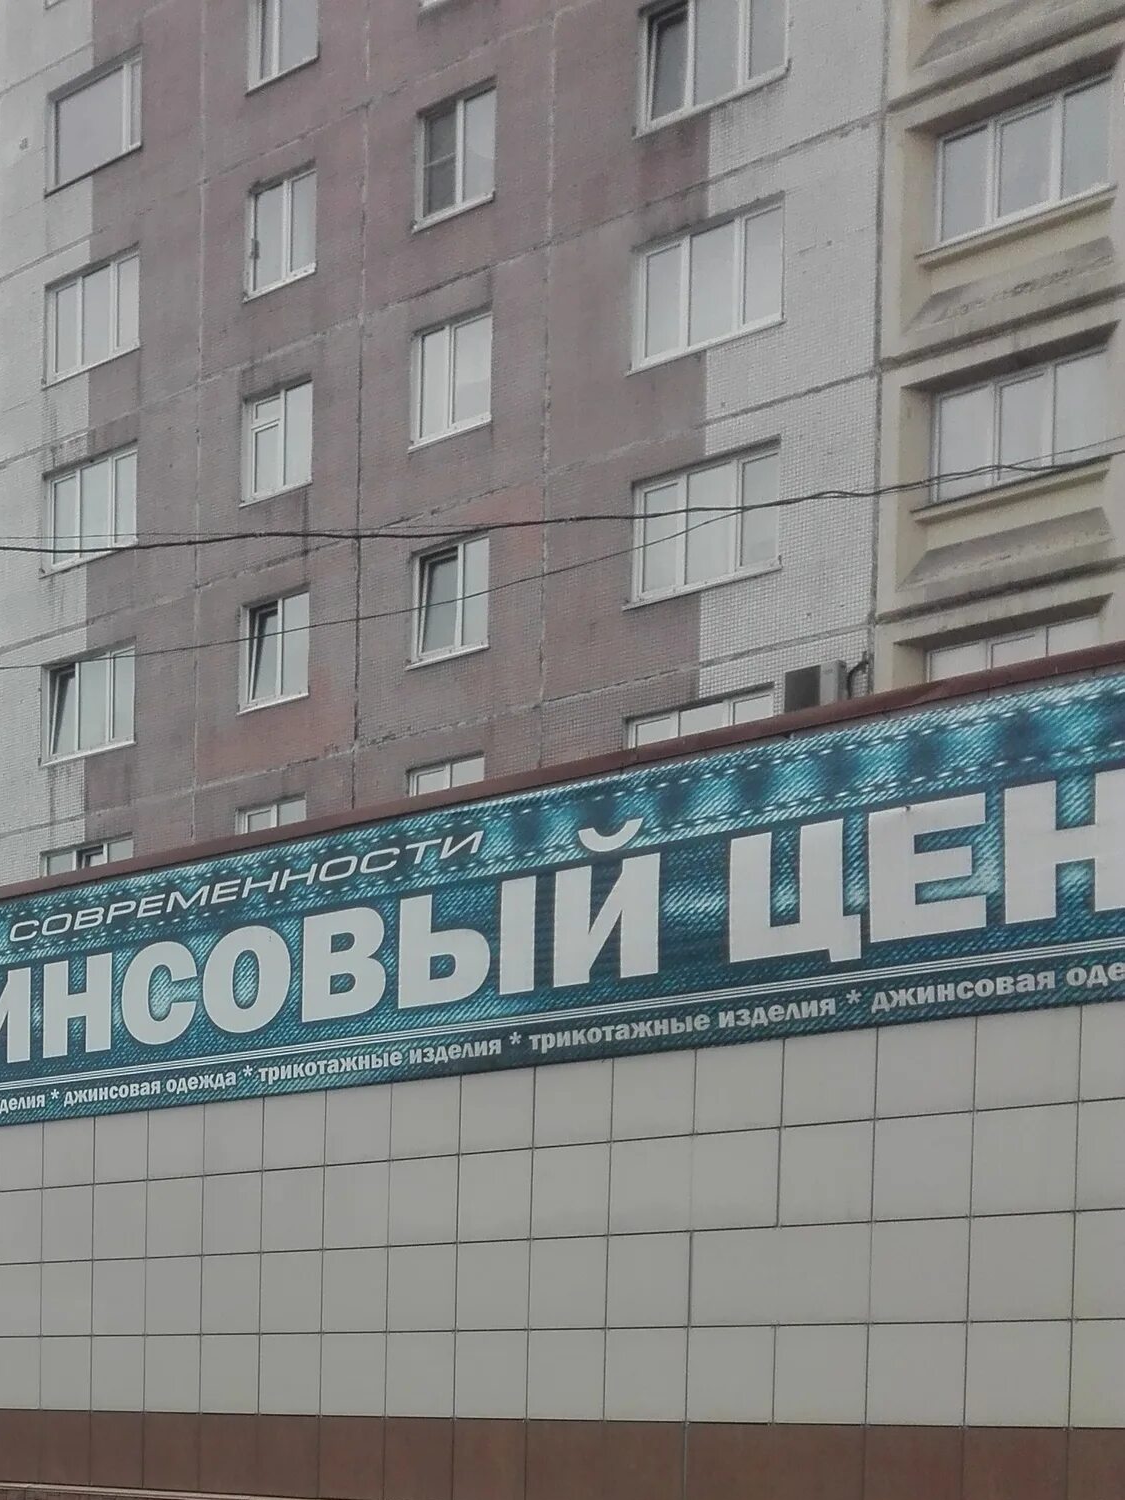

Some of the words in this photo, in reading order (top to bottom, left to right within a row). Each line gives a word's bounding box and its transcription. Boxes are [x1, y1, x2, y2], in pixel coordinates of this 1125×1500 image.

[10, 830, 484, 942] СОВРЕМЕННОСТИ
[730, 767, 1125, 964] ЦЕН
[64, 1079, 161, 1107] джинсовая
[166, 1070, 237, 1095] одежда
[259, 1046, 402, 1085] трикотажные
[409, 1035, 502, 1066] изделия
[529, 1010, 711, 1052] трикотажные
[719, 998, 836, 1030] изделия
[872, 969, 1055, 1014] джинсовая
